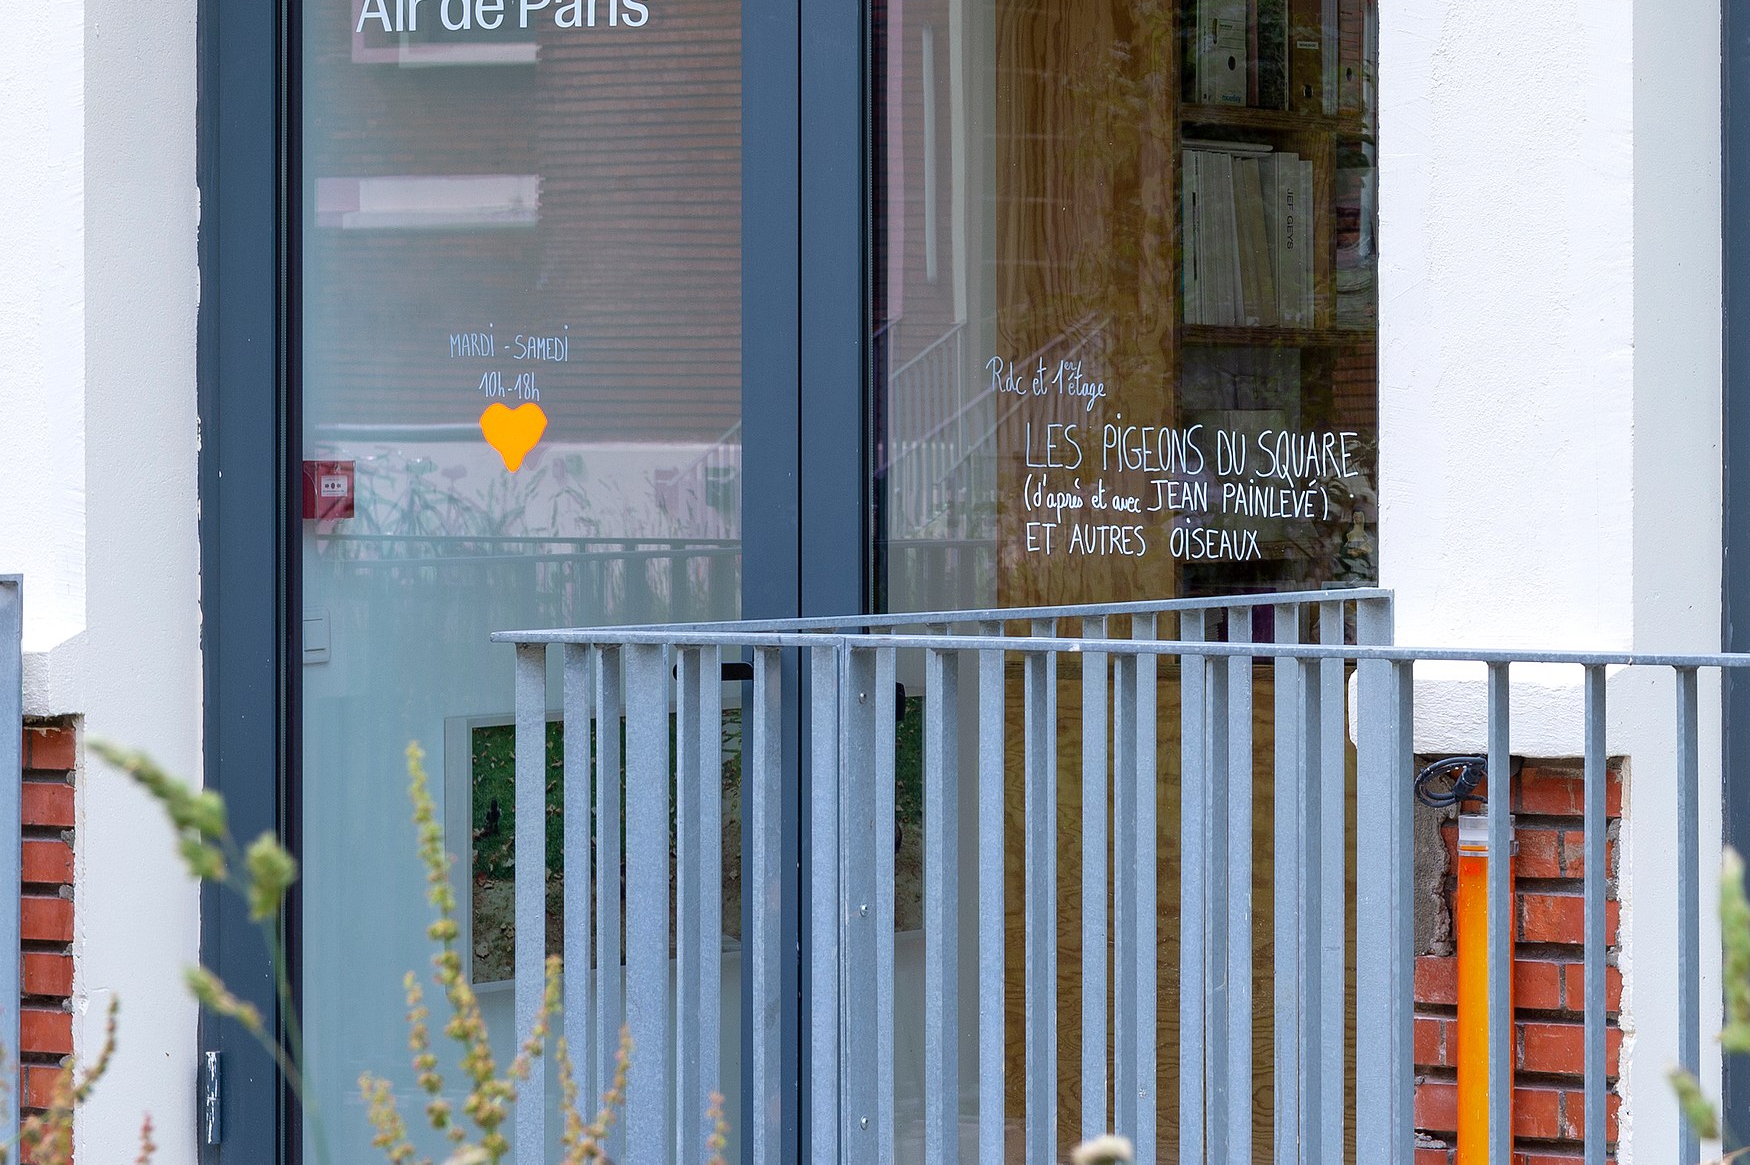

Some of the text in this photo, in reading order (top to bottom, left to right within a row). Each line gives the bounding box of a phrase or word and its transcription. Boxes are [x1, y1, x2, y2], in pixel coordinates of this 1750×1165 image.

[1286, 188, 1294, 250] JEF GEYS
[450, 323, 495, 358] MARDI
[513, 324, 568, 362] SAMEDI
[986, 356, 1027, 395] Rdc
[1033, 357, 1048, 395] et
[1067, 360, 1107, 412] étage
[1025, 413, 1359, 489] LES PIGEONS DU SQUARE
[1091, 479, 1107, 511] et
[1112, 494, 1142, 514] avec
[1147, 479, 1208, 513] JEAN
[1025, 517, 1262, 561] ET AUTRES OISEAUX
